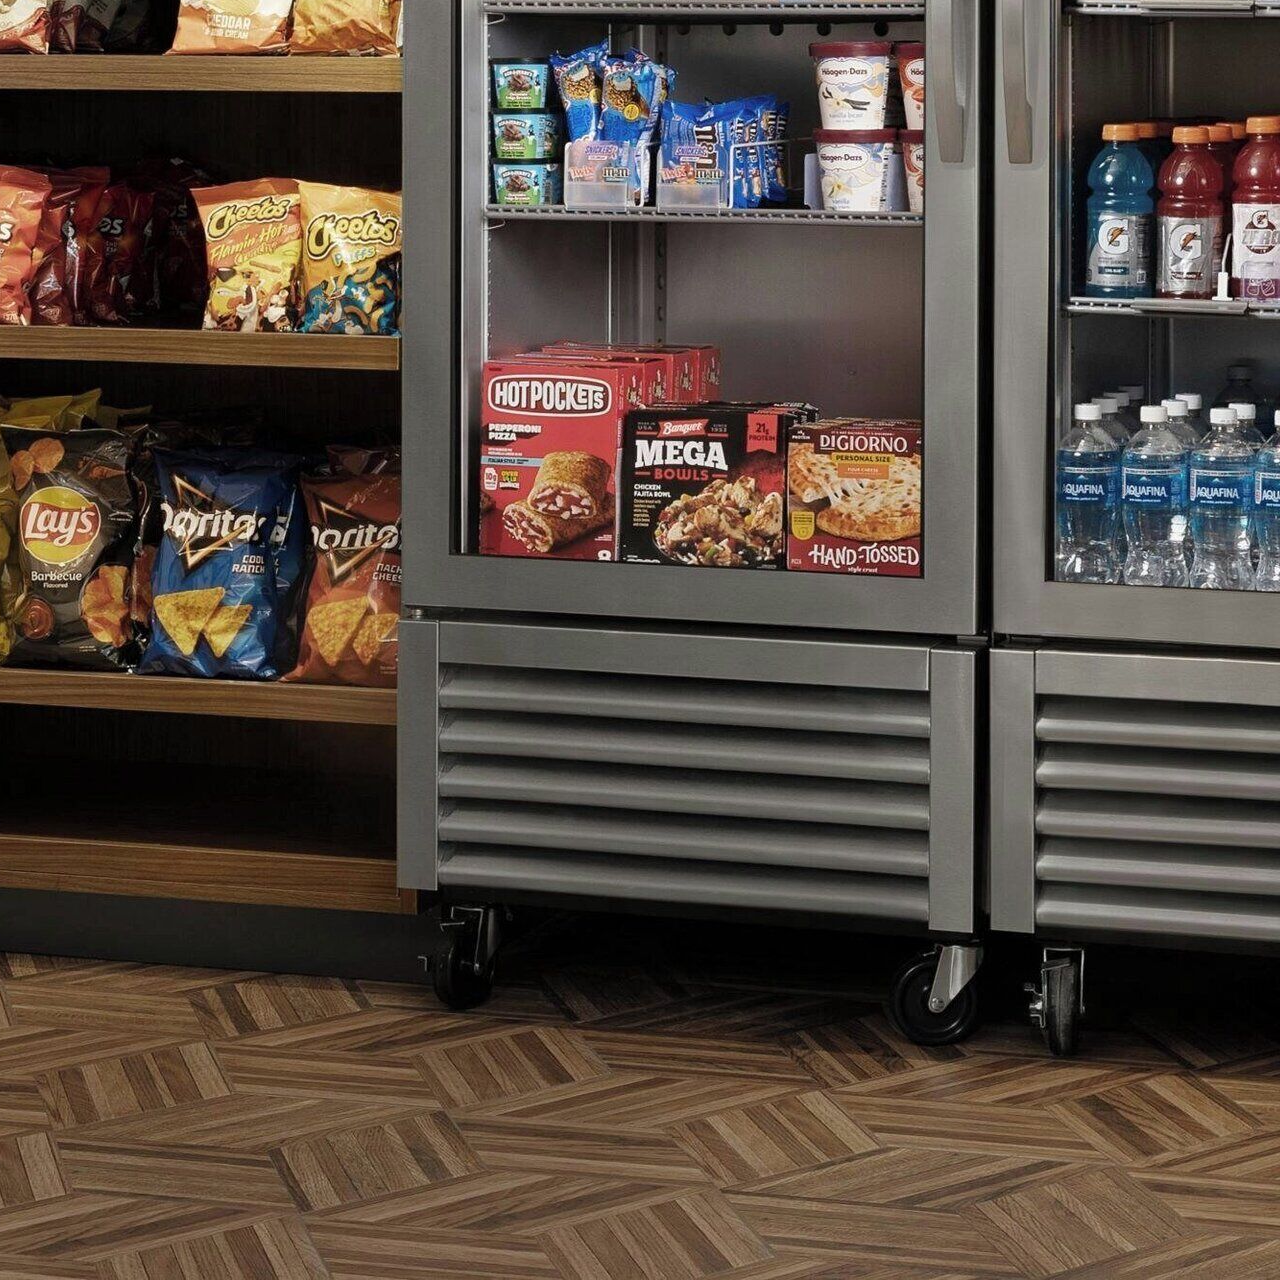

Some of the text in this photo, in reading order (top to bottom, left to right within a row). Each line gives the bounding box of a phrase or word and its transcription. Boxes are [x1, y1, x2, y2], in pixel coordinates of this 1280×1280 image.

[585, 146, 616, 155] SNICKERS
[206, 197, 290, 242] Cheetos
[306, 210, 399, 260] Cheetos
[210, 223, 285, 262] Flamin' Hot
[489, 424, 541, 433] PEPPERONI
[663, 422, 702, 435] Banquet
[489, 432, 516, 441] PIZZA
[635, 440, 728, 470] MEGA
[654, 469, 709, 481] BOWLS
[1125, 484, 1167, 497] AQUAFINA
[1197, 487, 1240, 499] AQUAFINA
[24, 503, 94, 546] Lay's
[242, 555, 264, 564] COOL
[232, 564, 265, 574] RANCH
[376, 563, 401, 574] NACH
[31, 571, 82, 582] Barbecue
